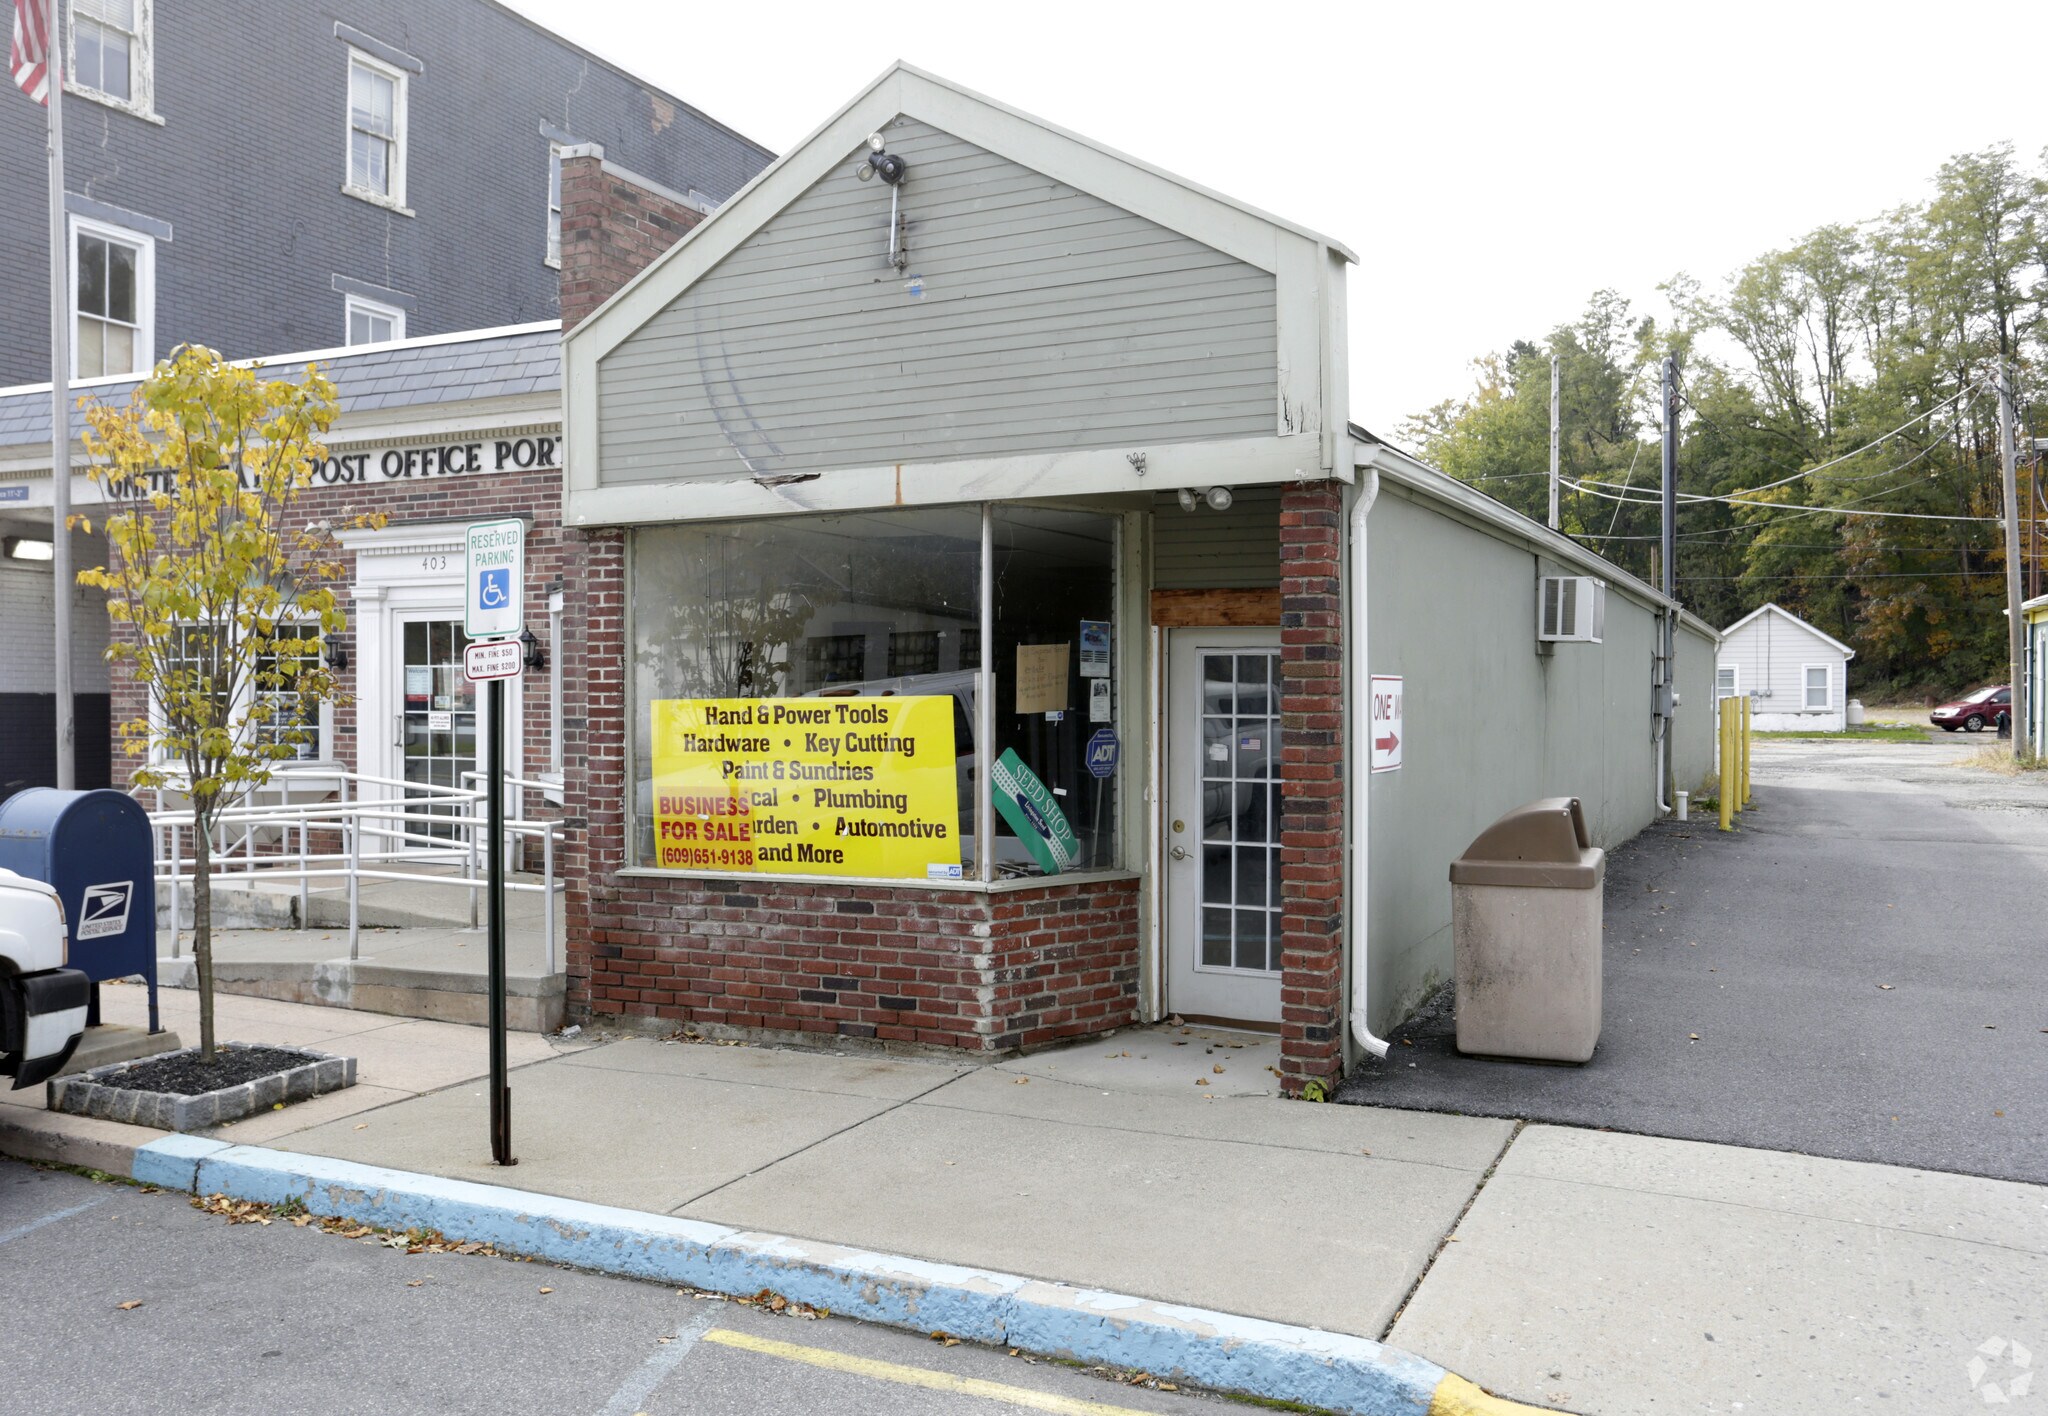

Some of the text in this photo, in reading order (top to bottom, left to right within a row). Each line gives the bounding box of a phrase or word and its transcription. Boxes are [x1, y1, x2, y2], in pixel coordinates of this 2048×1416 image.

[306, 453, 370, 484] POST
[381, 443, 482, 478] OFFICE
[471, 530, 518, 550] RESERVED
[422, 556, 447, 570] 403
[475, 549, 514, 567] PARKING
[474, 648, 513, 660] MIN. FINE $50
[472, 661, 516, 673] MAX. FINE $200
[705, 704, 888, 725] Hand & Power Tools
[1373, 693, 1392, 720] ONE
[684, 731, 915, 757] Hardware Key Cutting
[1092, 744, 1116, 762] ADT
[722, 760, 874, 781] Paint & Sundries
[660, 796, 749, 816] BUSINESS
[813, 787, 908, 814] Plumbing
[1012, 764, 1045, 802] SEED
[1041, 798, 1071, 841] SHOP
[661, 821, 751, 841] FOR SALE
[835, 816, 946, 838] Automotive
[662, 847, 754, 867] (609)651-9138
[758, 843, 844, 864] and More
